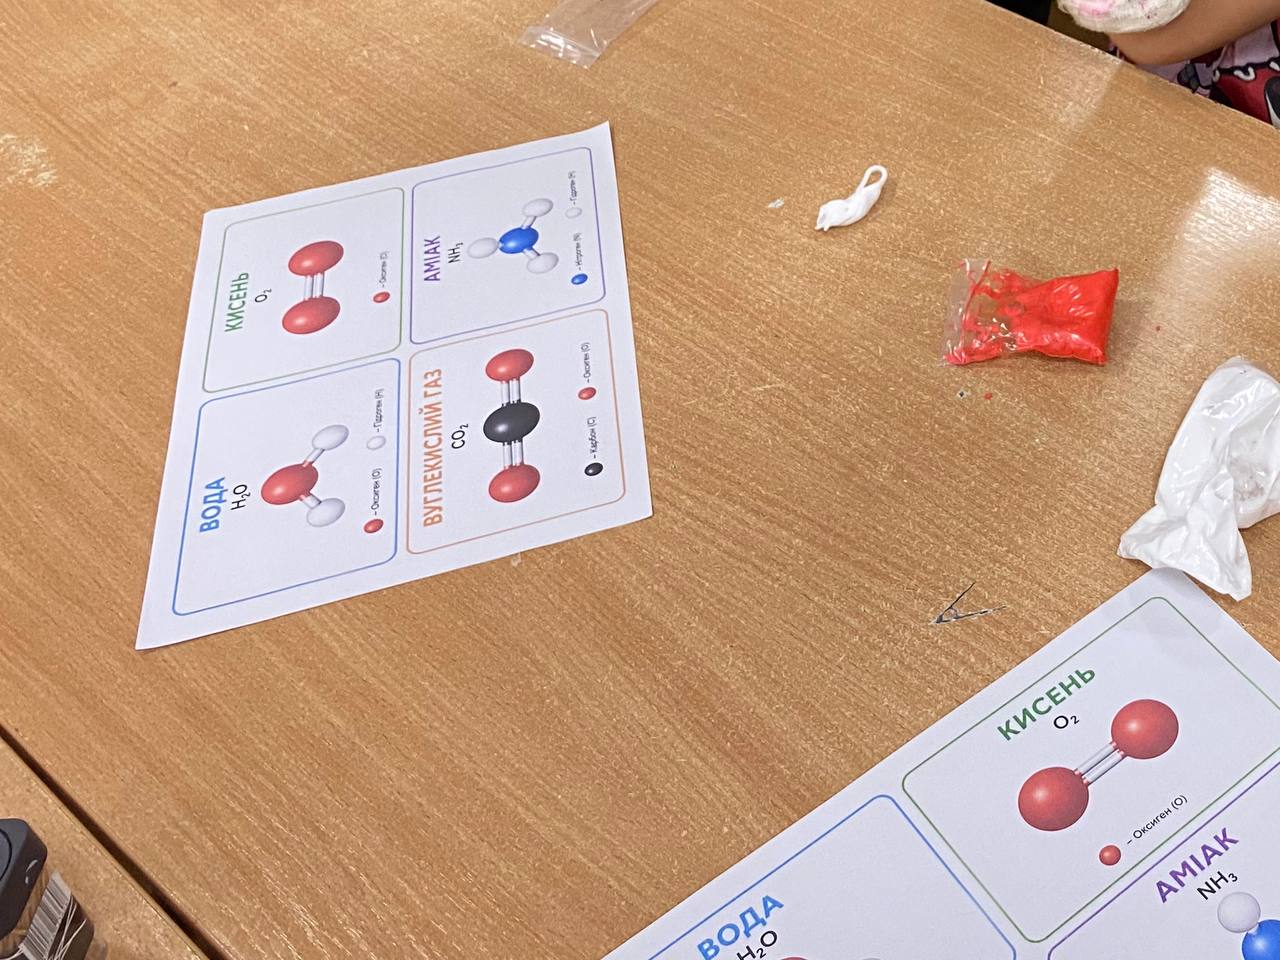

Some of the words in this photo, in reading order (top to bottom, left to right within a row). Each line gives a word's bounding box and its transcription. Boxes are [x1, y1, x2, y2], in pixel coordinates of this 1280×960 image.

[424, 235, 441, 282] АМІАК
[224, 272, 249, 332] КИСЕНЬ
[424, 368, 442, 398] ГАЗ
[419, 401, 443, 527] ВУГЛЕКИСЛИЙ
[199, 477, 228, 532] ВОДА
[997, 669, 1096, 741] КИСЕНЬ
[1133, 808, 1172, 839] Оксиген
[1155, 827, 1240, 903] АМІАК
[696, 895, 785, 960] ВОДА
